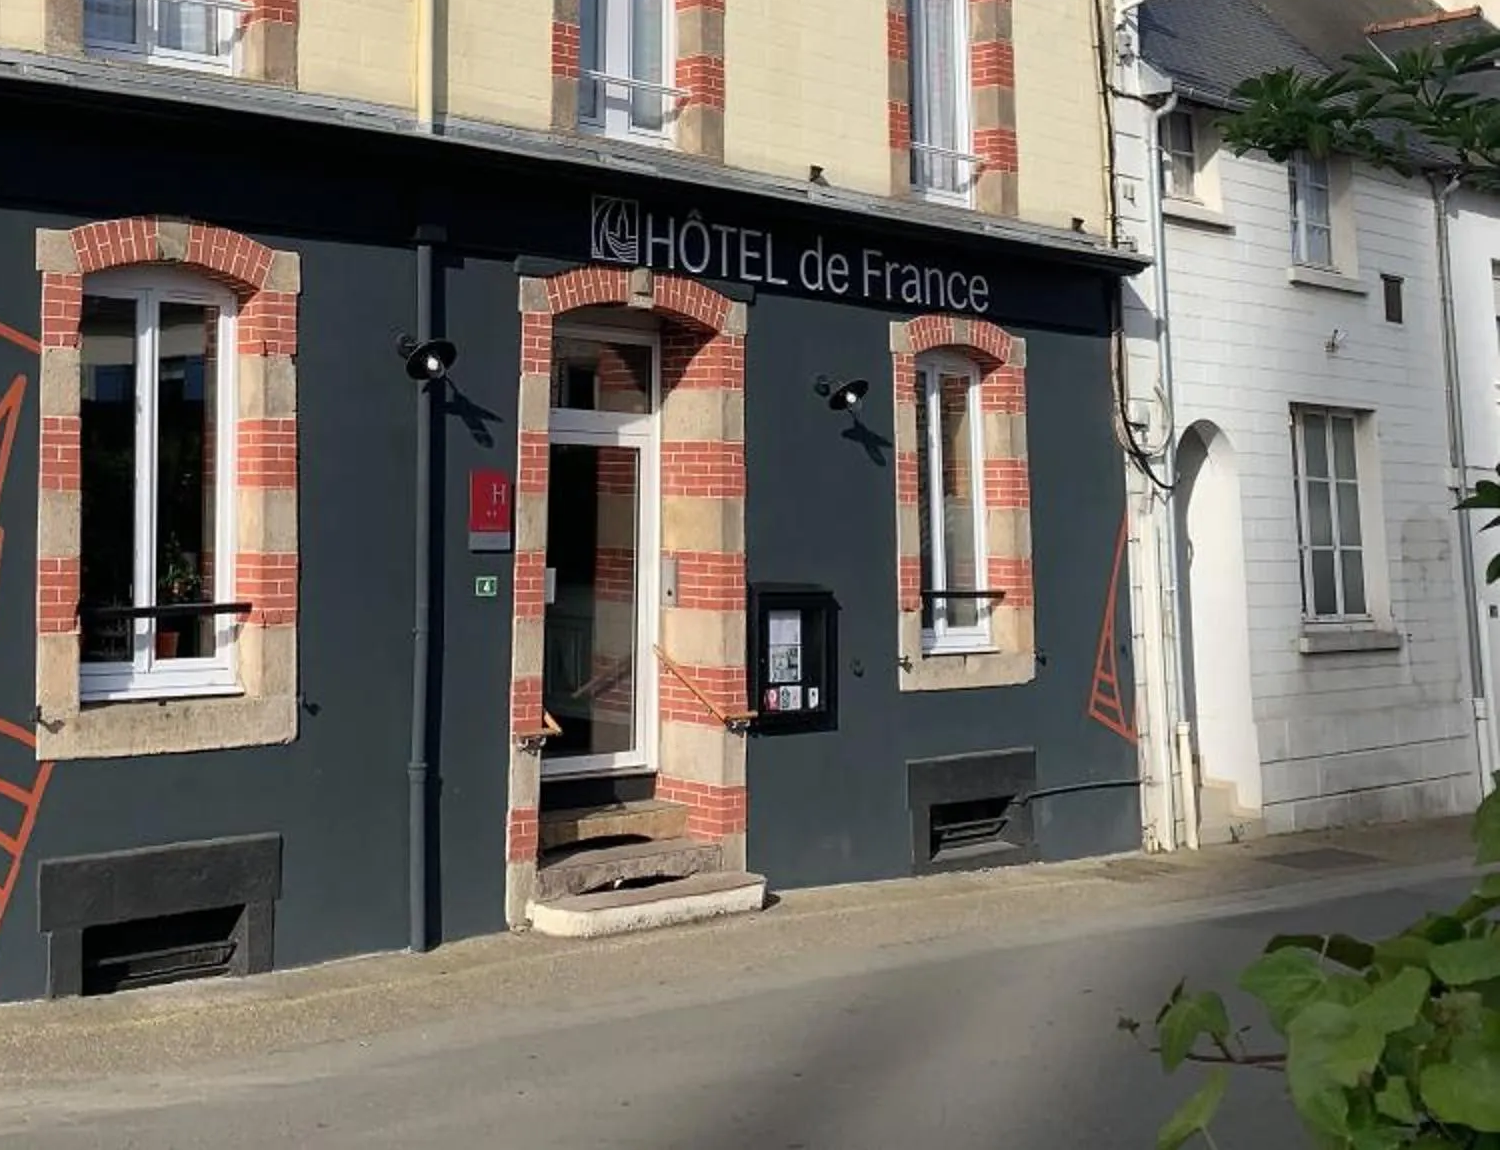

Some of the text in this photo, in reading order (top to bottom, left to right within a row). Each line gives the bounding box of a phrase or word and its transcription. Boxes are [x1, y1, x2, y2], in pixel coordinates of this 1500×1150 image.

[646, 209, 990, 313] HÔTEL de France
[492, 482, 507, 505] H
